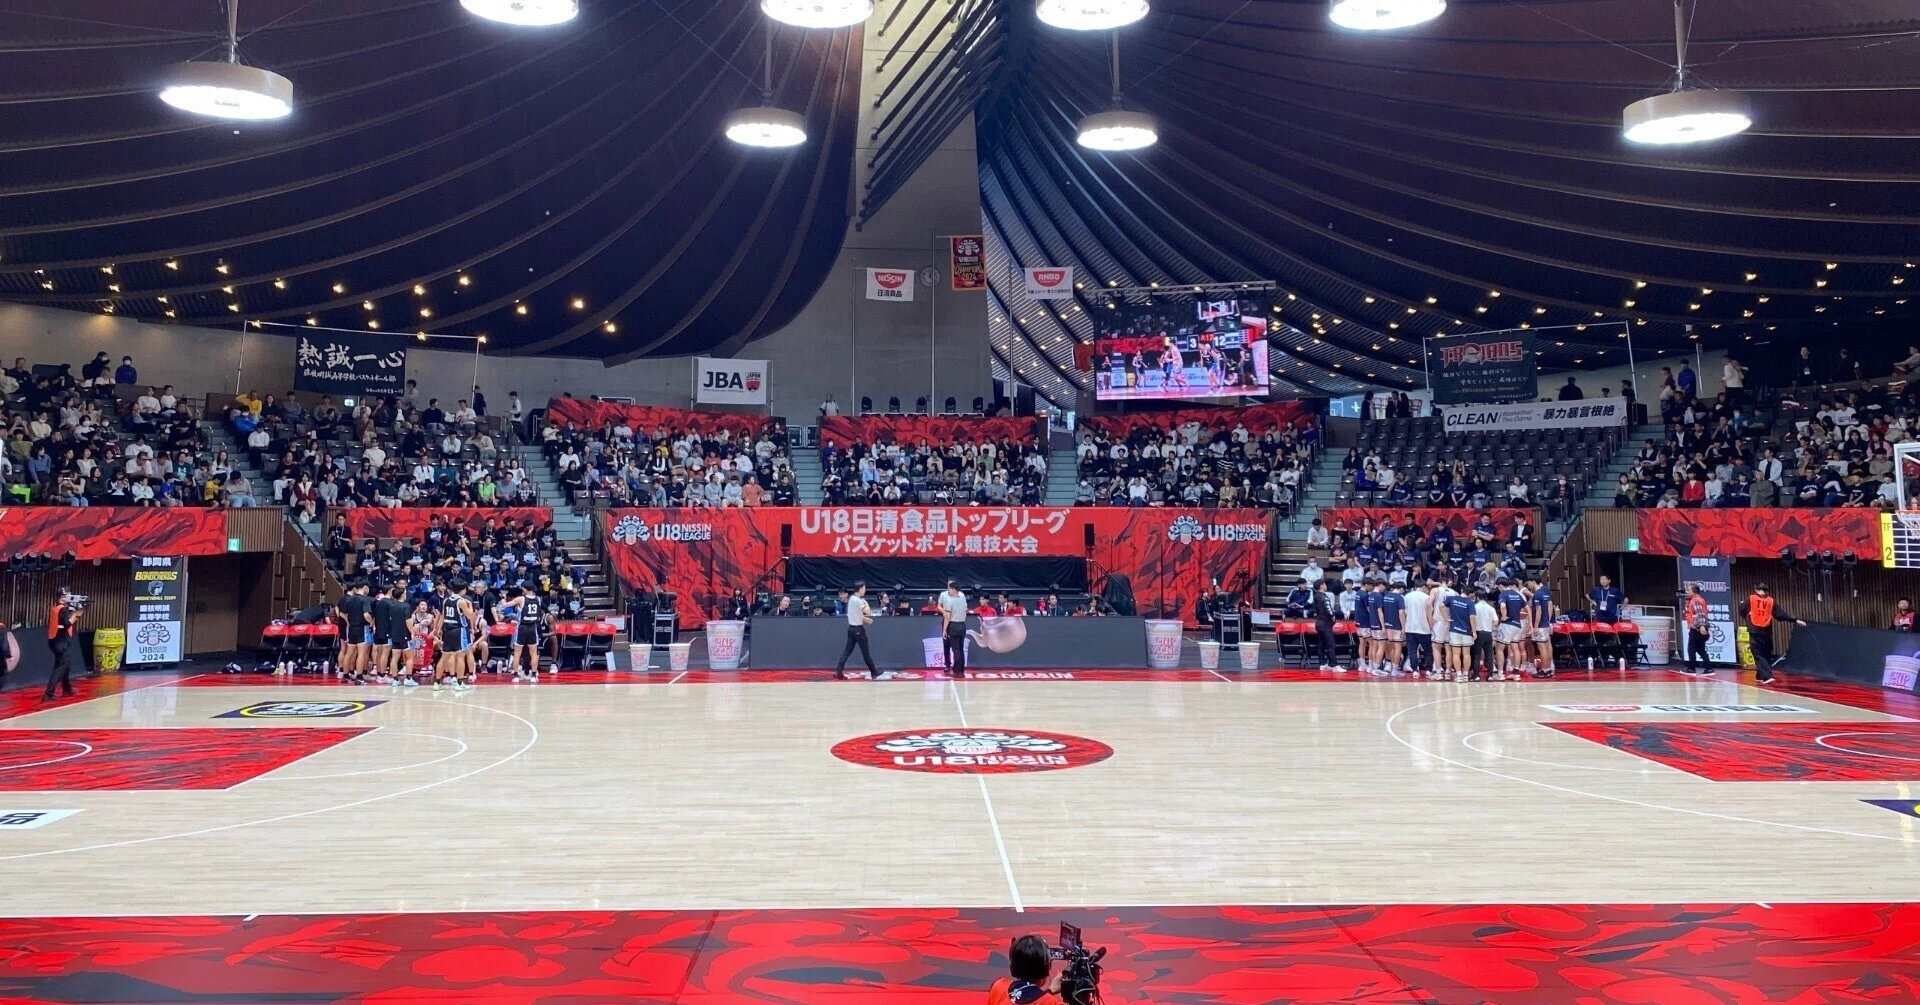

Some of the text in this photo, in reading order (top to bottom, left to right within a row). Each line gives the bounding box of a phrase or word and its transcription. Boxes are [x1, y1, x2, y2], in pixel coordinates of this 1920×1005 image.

[878, 274, 903, 283] NISSIN
[1038, 273, 1060, 281] ANDO
[877, 289, 903, 298] 日清食品
[1189, 338, 1197, 348] 3
[1214, 336, 1226, 346] 12
[298, 337, 405, 370] 熱誠一心
[1440, 341, 1524, 368] TROJANS
[703, 371, 744, 389] JBA
[1543, 405, 1615, 420] 暴力暴言根絶
[1447, 412, 1498, 426] CLEAN
[801, 508, 1071, 534] U18日清食品トップリーグ
[653, 523, 712, 541] U18 NISSIN
[1883, 522, 1892, 532] TF
[681, 532, 712, 541] LEAGUE
[1207, 524, 1266, 542] U18 NISSIN
[1235, 532, 1266, 542] LEAGUE
[1885, 546, 1893, 561] 2
[142, 557, 172, 567] 静岡県
[1691, 557, 1718, 567] 福岡県
[527, 603, 538, 615] 13
[1756, 600, 1768, 609] TV
[445, 605, 455, 618] 10
[139, 646, 153, 654] U18
[141, 653, 165, 661] 2024
[893, 755, 976, 765] U18
